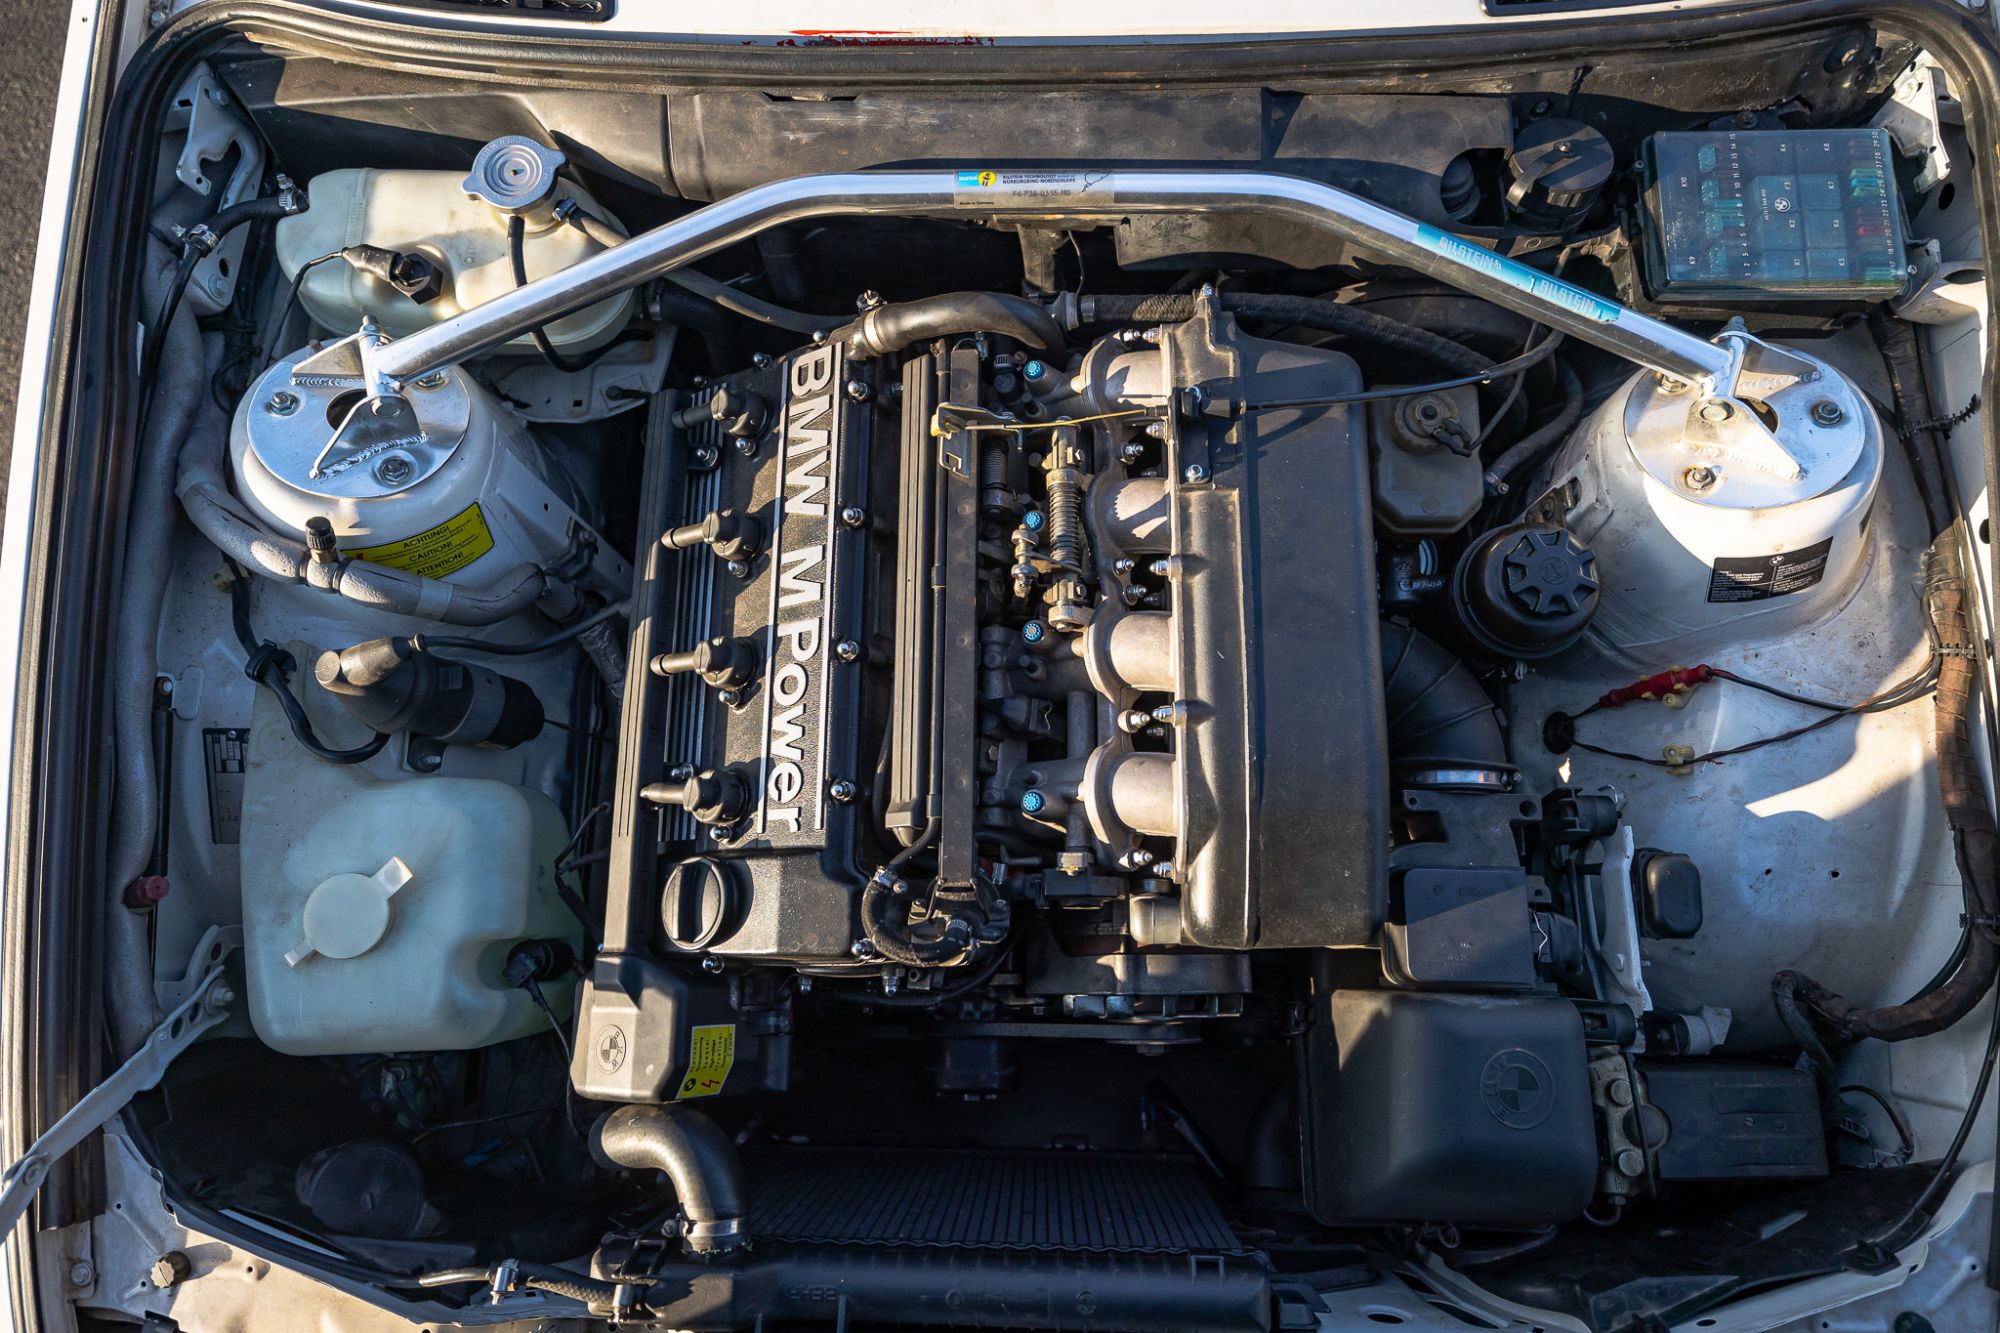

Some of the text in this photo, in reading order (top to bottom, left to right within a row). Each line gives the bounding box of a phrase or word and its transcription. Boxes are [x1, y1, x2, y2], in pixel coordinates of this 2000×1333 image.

[1824, 143, 1845, 266] K5 K6 K7 K8
[1439, 236, 1494, 270] BILSTEIN
[1689, 256, 1696, 264] K9
[1540, 279, 1594, 312] BILSTEIN
[785, 346, 833, 517] BMW
[403, 525, 450, 549] ACHTUNG!
[410, 541, 453, 562] CAUTION!
[416, 552, 464, 575] ATTENTION!
